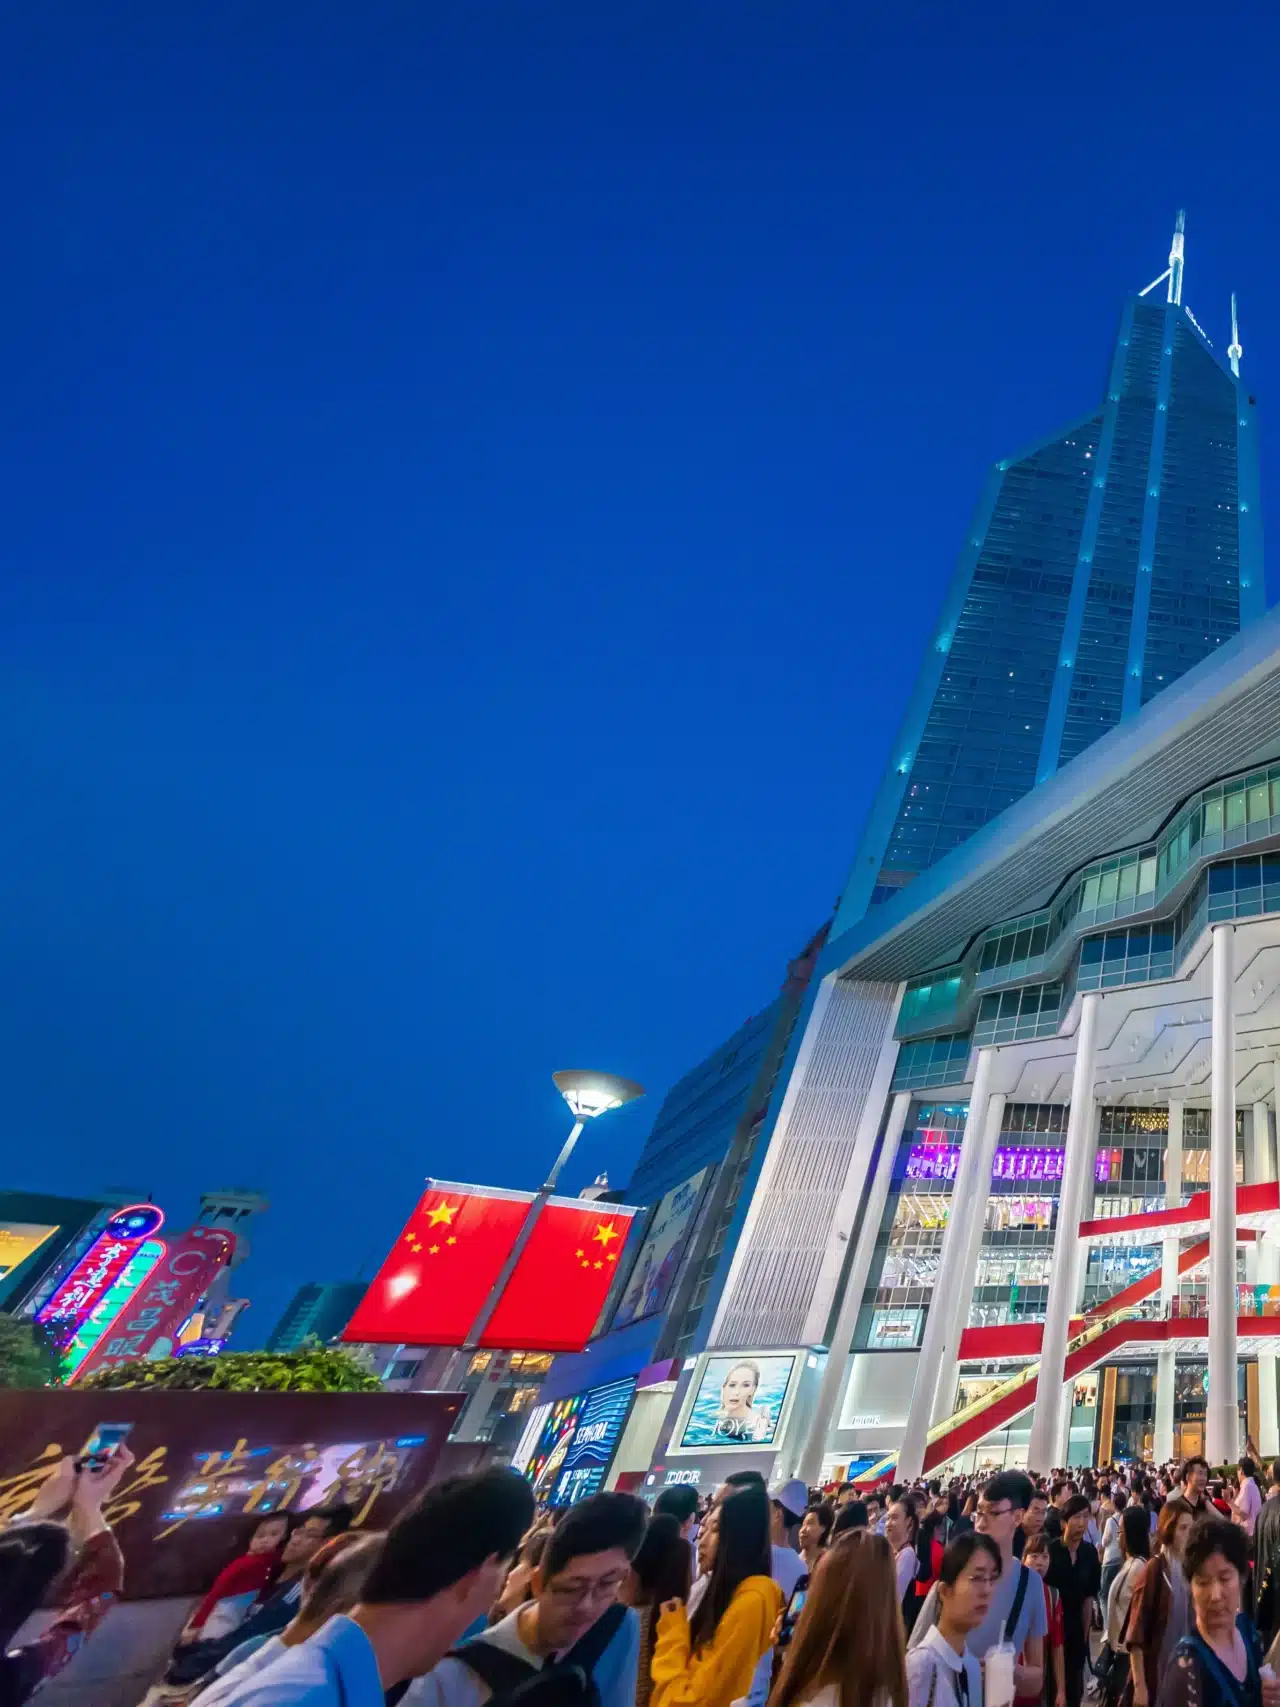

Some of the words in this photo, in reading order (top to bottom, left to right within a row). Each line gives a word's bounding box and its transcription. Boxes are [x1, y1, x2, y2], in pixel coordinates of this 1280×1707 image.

[94, 1279, 181, 1371] 茂昌眼
[711, 1419, 746, 1436] JOY
[664, 1470, 701, 1484] DIOR
